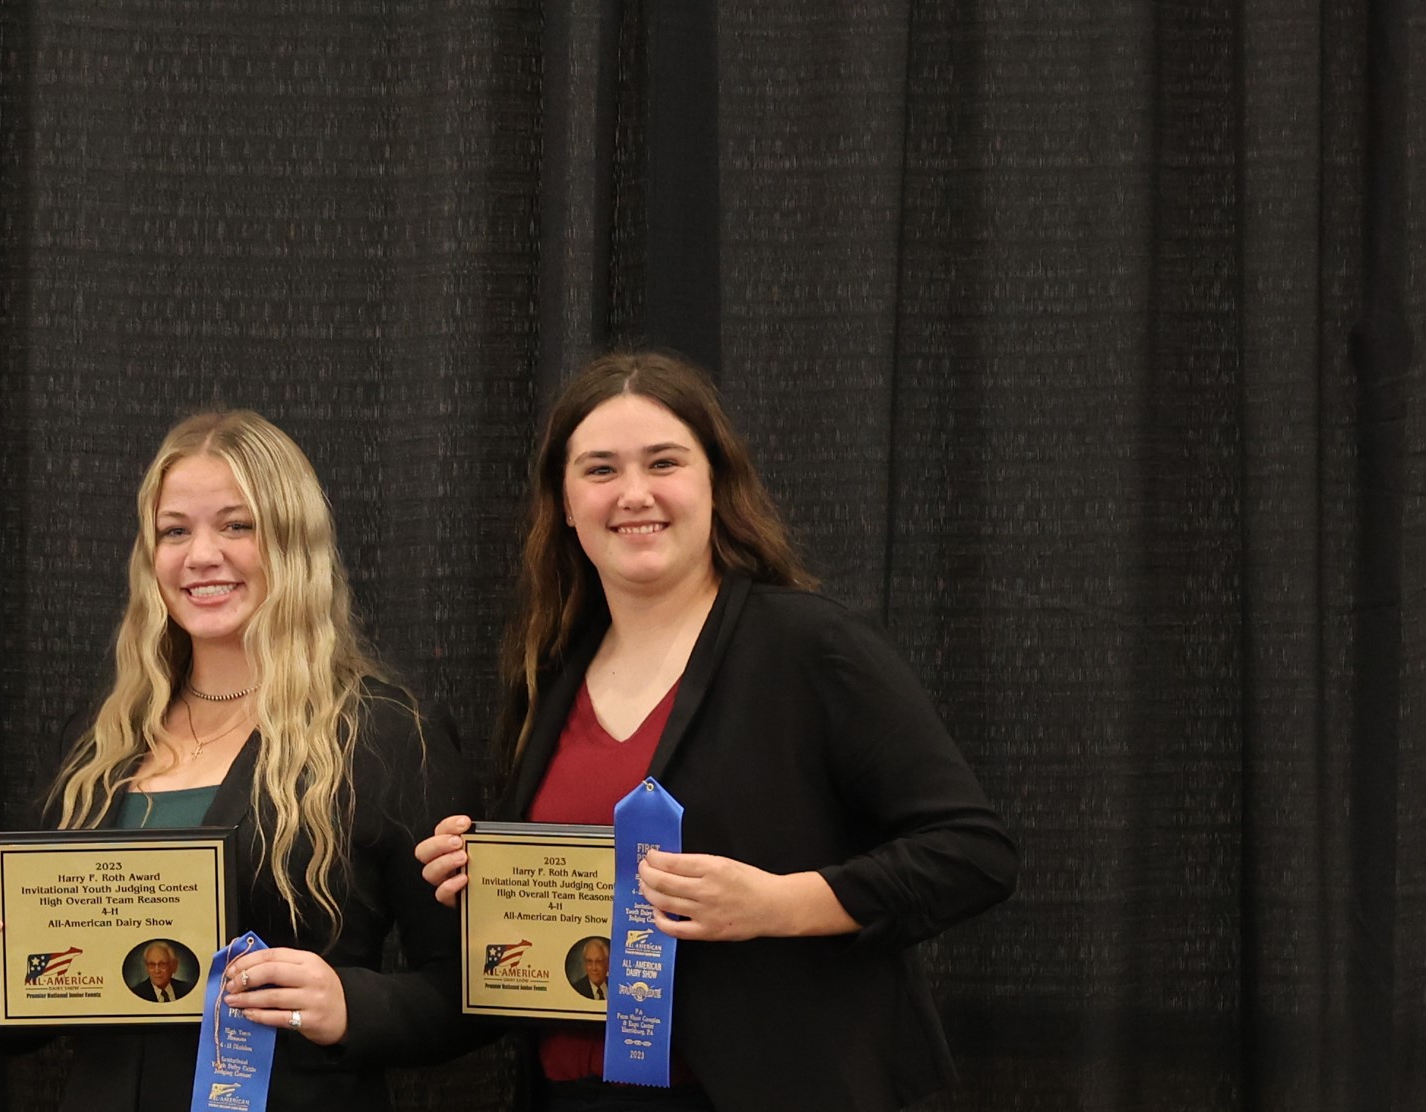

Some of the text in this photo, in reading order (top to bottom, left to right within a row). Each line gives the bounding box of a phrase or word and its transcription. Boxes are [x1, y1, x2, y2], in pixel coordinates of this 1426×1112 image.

[638, 843, 660, 853] FIRT
[96, 862, 122, 870] 2023
[544, 857, 566, 866] 2023
[512, 867, 535, 877] Harry
[549, 869, 568, 877] Roth
[572, 870, 598, 878] Award
[58, 874, 85, 883] Harry
[102, 873, 125, 882] Roth
[129, 873, 160, 881] Award
[482, 877, 529, 887] Invitational
[533, 879, 556, 888] Youth
[560, 880, 593, 891] Judging
[22, 884, 198, 895] Invitational Youth Judging Contest
[497, 889, 614, 901] High Overall Team Reasons
[40, 895, 180, 907] High Overall Team Reasons
[548, 902, 562, 910] 4-H
[102, 907, 118, 915] 4-H
[48, 918, 173, 928] All-American Dairy Show
[504, 912, 608, 924] All-American Dairy Show
[626, 968, 657, 978] DAIRY SHOW
[24, 976, 104, 985] ALL-AMERICAN
